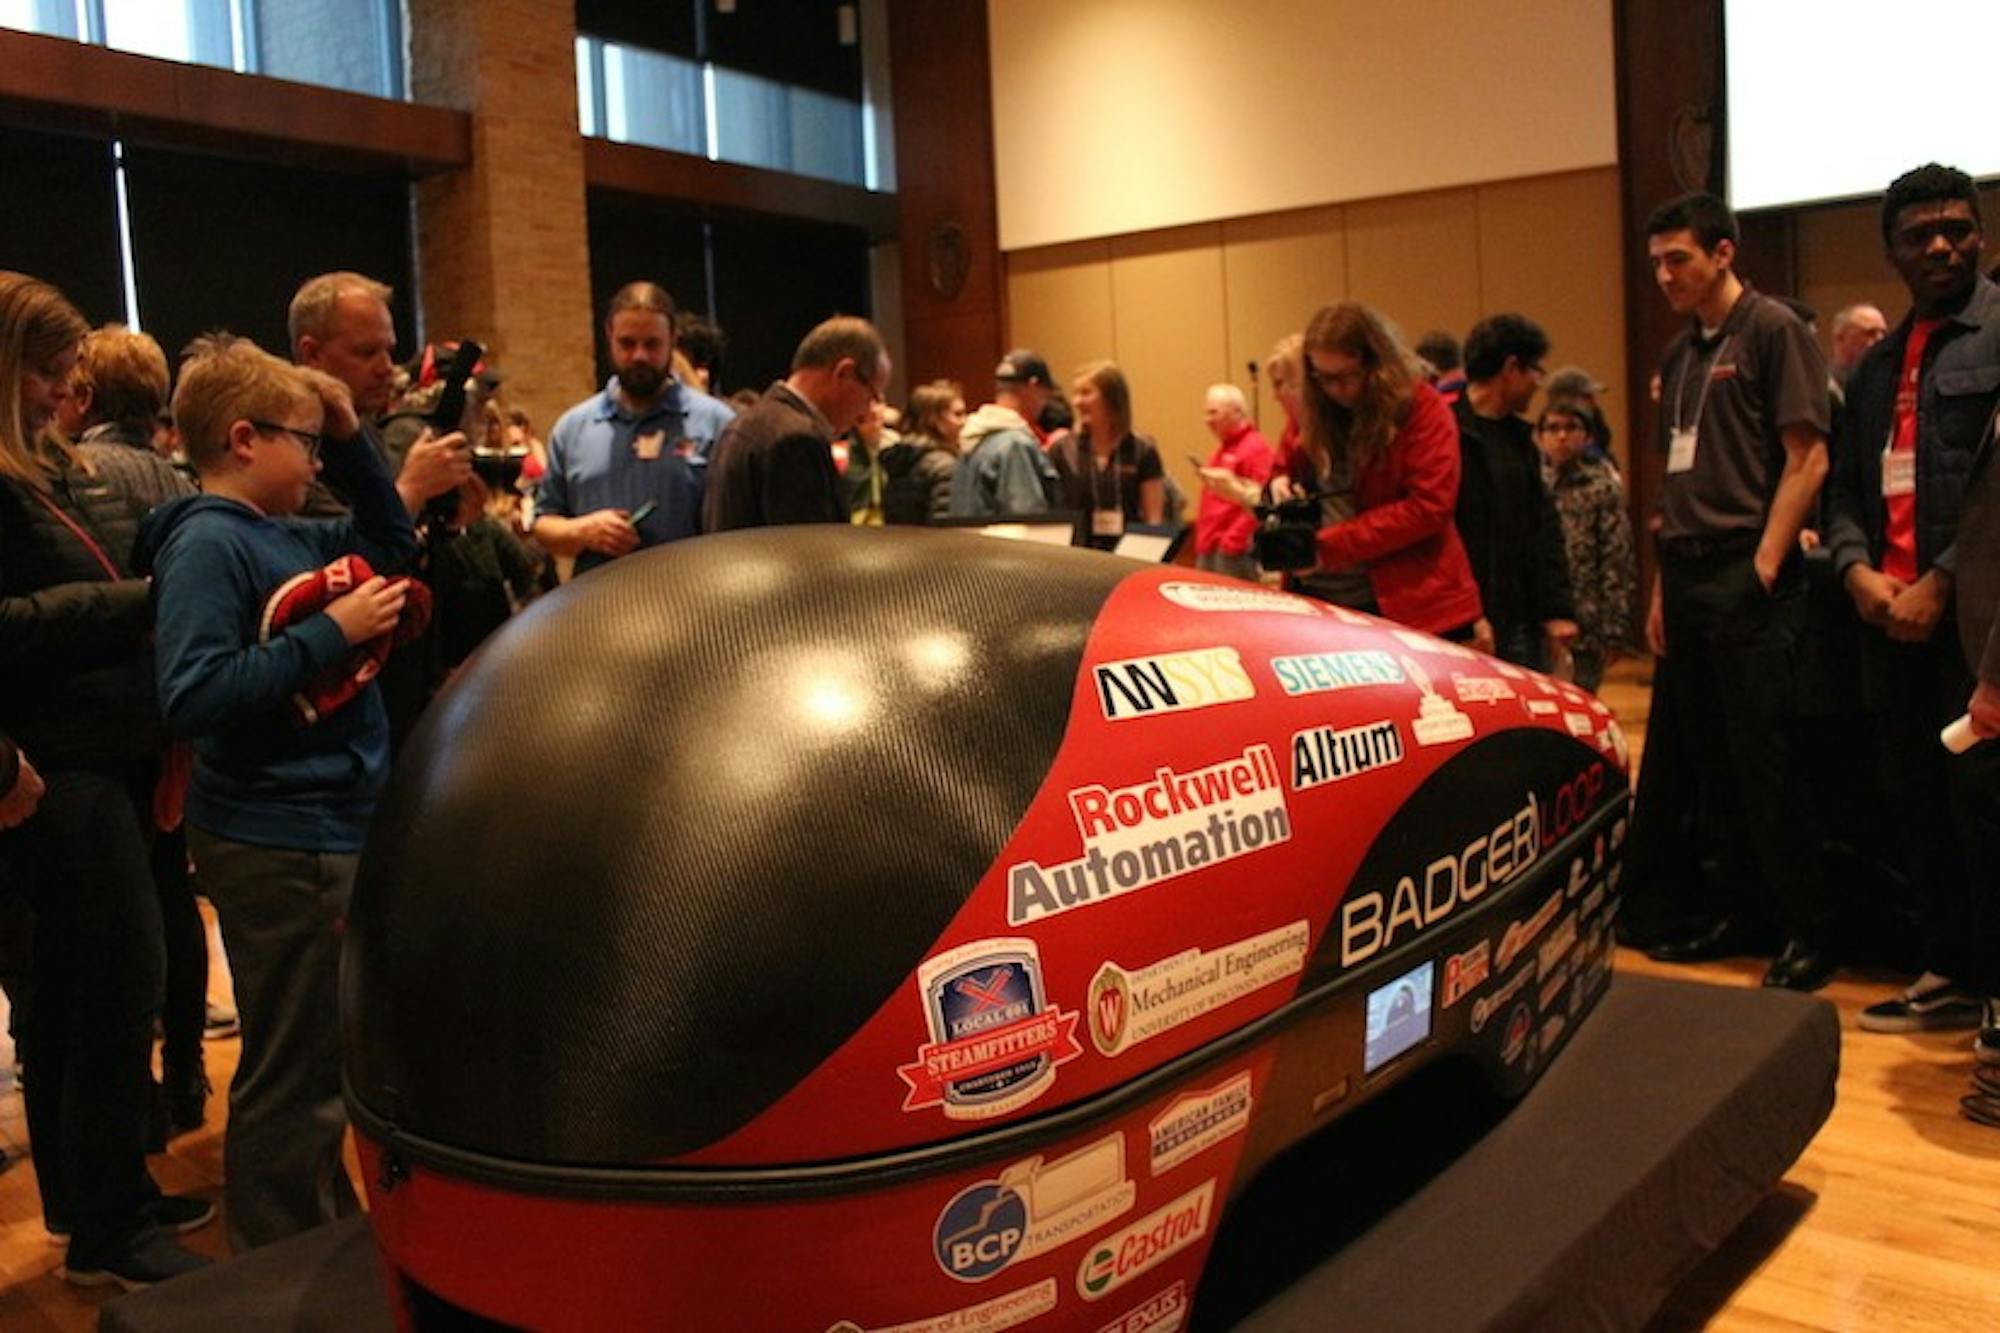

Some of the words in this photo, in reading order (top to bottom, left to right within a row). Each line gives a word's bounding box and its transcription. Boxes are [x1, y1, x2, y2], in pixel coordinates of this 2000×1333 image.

[1275, 651, 1402, 692] SIEMENS
[1293, 723, 1401, 788] Altium
[1074, 749, 1278, 838] Rockwell
[1012, 806, 1288, 922] Automation
[1341, 800, 1537, 968] BADGER
[1131, 957, 1220, 1017] Mechanical
[1225, 930, 1306, 975] Engineering
[926, 1019, 1058, 1076] STEAMFITTERS
[953, 1011, 1000, 1035] LOCAL
[1131, 1005, 1190, 1040] UNIVERSITY
[1154, 1105, 1209, 1141] AMERICAN
[1212, 1084, 1247, 1109] FAMILY
[1027, 1188, 1132, 1247] TRANSPORTATION
[1117, 1195, 1204, 1277] Castrol
[951, 1227, 1021, 1271] BCP
[961, 1283, 1051, 1324] Engineering
